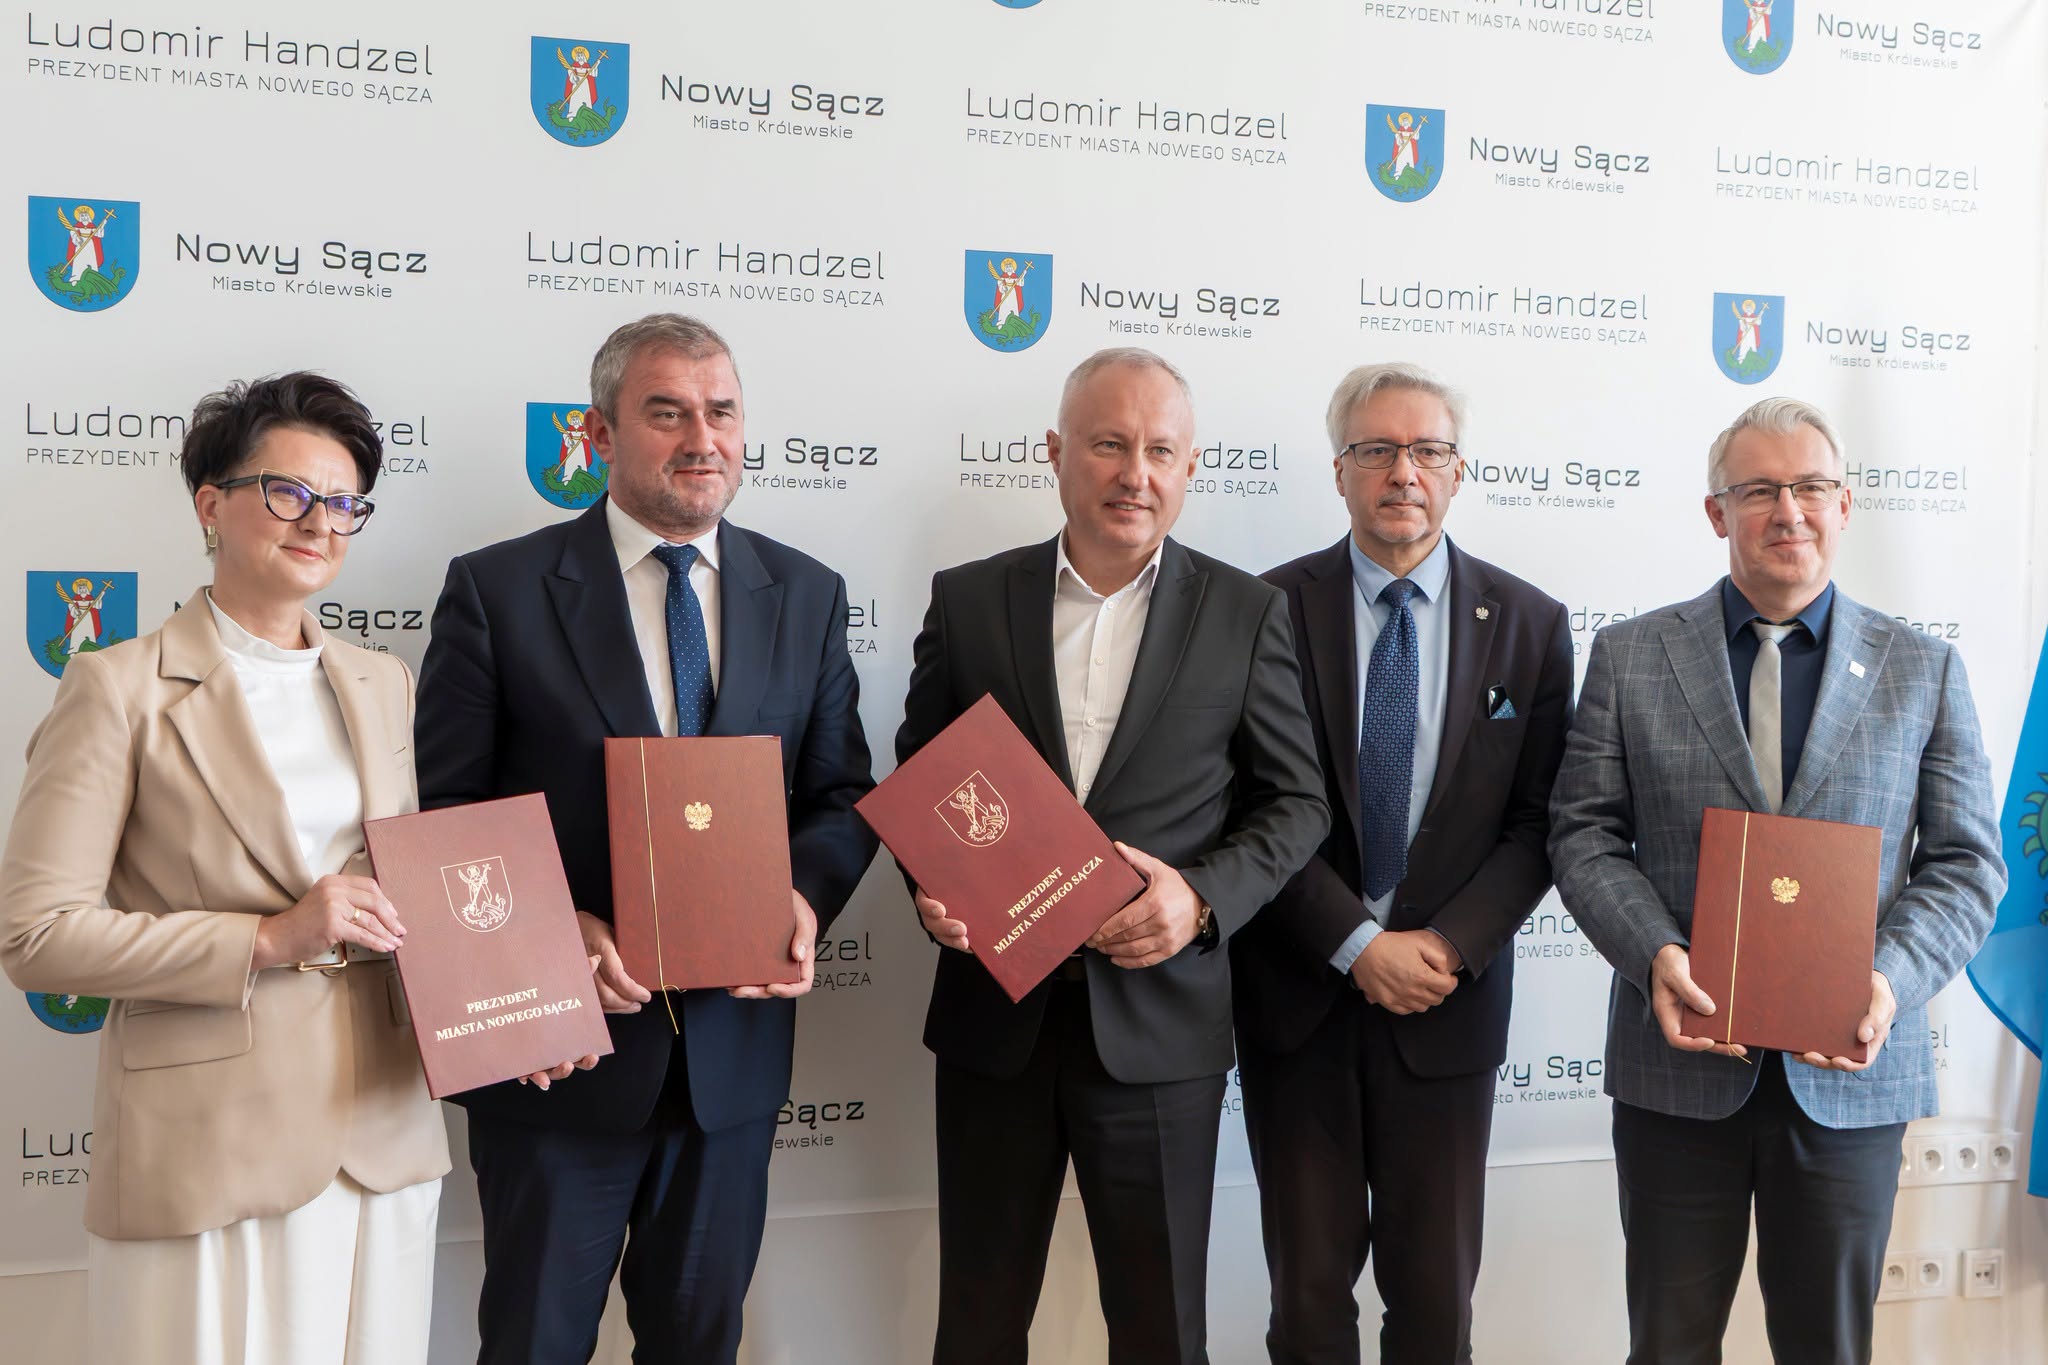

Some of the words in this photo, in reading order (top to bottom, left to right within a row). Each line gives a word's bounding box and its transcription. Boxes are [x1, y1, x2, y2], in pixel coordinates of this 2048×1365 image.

[1364, 3, 1459, 24] PREZYDENT
[1467, 12, 1521, 31] MIASTA
[1528, 18, 1598, 39] NOWEGO
[1604, 25, 1654, 43] SĄCZA
[1818, 13, 1898, 46] Nowy
[1912, 22, 1981, 50] Sącz
[28, 12, 223, 59] Ludomir
[246, 30, 432, 75] Handzel
[1840, 48, 1884, 63] Miasto
[1887, 52, 1960, 70] Królewskie
[29, 58, 162, 83] PREZYDENT
[172, 69, 248, 89] MIASTA
[259, 76, 353, 97] NOWEGO
[364, 84, 432, 104] SĄCZA
[662, 74, 770, 112] Nowy
[791, 84, 884, 118] Sącz
[694, 115, 749, 131] Miasto
[757, 119, 853, 139] Królewskie
[968, 89, 1122, 127] Ludomir
[1138, 101, 1287, 140] Handzel
[967, 128, 1072, 151] PREZYDENT
[1080, 136, 1140, 154] MIASTA
[1148, 141, 1224, 160] NOWEGO
[1232, 148, 1286, 165] SĄCZA
[1470, 137, 1558, 170] Nowy
[1575, 145, 1649, 174] Sącz
[1495, 173, 1540, 188] Miasto
[1547, 176, 1624, 194] Królewskie
[1717, 146, 1843, 181] Ludomir
[1856, 157, 1978, 191] Handzel
[177, 234, 299, 273] Nowy
[323, 243, 427, 278] Sącz
[528, 232, 700, 270] Ludomir
[719, 242, 884, 280] Handzel
[213, 276, 279, 294] Miasto
[285, 278, 392, 298] Królewskie
[528, 274, 645, 295] PREZYDENT
[654, 280, 721, 298] MIASTA
[730, 283, 814, 304] NOWEGO
[823, 288, 884, 307] SĄCZA
[1081, 284, 1178, 317] Nowy
[1197, 290, 1280, 320] Sącz
[1360, 278, 1499, 312] Ludomir
[1514, 287, 1648, 320] Handzel
[1109, 320, 1159, 335] Miasto
[1166, 322, 1252, 338] Królewskie
[1360, 315, 1455, 334] PREZYDENT
[1461, 321, 1517, 336] MIASTA
[1522, 325, 1591, 342] NOWEGO
[1597, 328, 1647, 345] SĄCZA
[1807, 322, 1887, 351] Nowy
[1902, 326, 1970, 353] Sącz
[1829, 354, 1870, 368] Miasto
[1877, 356, 1947, 371] Królewskie
[27, 403, 185, 439] Ludom
[27, 448, 159, 466] PREZYDENT
[785, 439, 878, 472] Sącz
[961, 433, 1047, 464] Ludo
[1203, 441, 1279, 470] dzel
[752, 474, 847, 490] Królewskie
[960, 472, 1054, 488] PREZYDEN
[1224, 480, 1279, 497] SĄCZA
[1462, 458, 1549, 489] Nowy
[1565, 464, 1640, 491] Sącz
[1846, 461, 1967, 490] Handzel
[1486, 493, 1531, 507] Miasto
[1538, 495, 1615, 509] Królewskie
[319, 602, 423, 637] Sącz
[993, 919, 1032, 954] MIASTA
[1029, 882, 1073, 922] NOWEGO
[1071, 856, 1104, 885] SĄCZA
[1008, 866, 1064, 919] PREZYDENT
[1516, 943, 1574, 959] OWEGO
[466, 988, 539, 1014] PREZYDENT
[436, 1020, 485, 1041] MIASTA
[486, 1007, 542, 1029] NOWEGO
[543, 998, 583, 1015] SĄCZA
[1547, 1056, 1602, 1084] Sąc
[1520, 1087, 1597, 1103] Królewskie
[774, 1133, 834, 1149] ewskie
